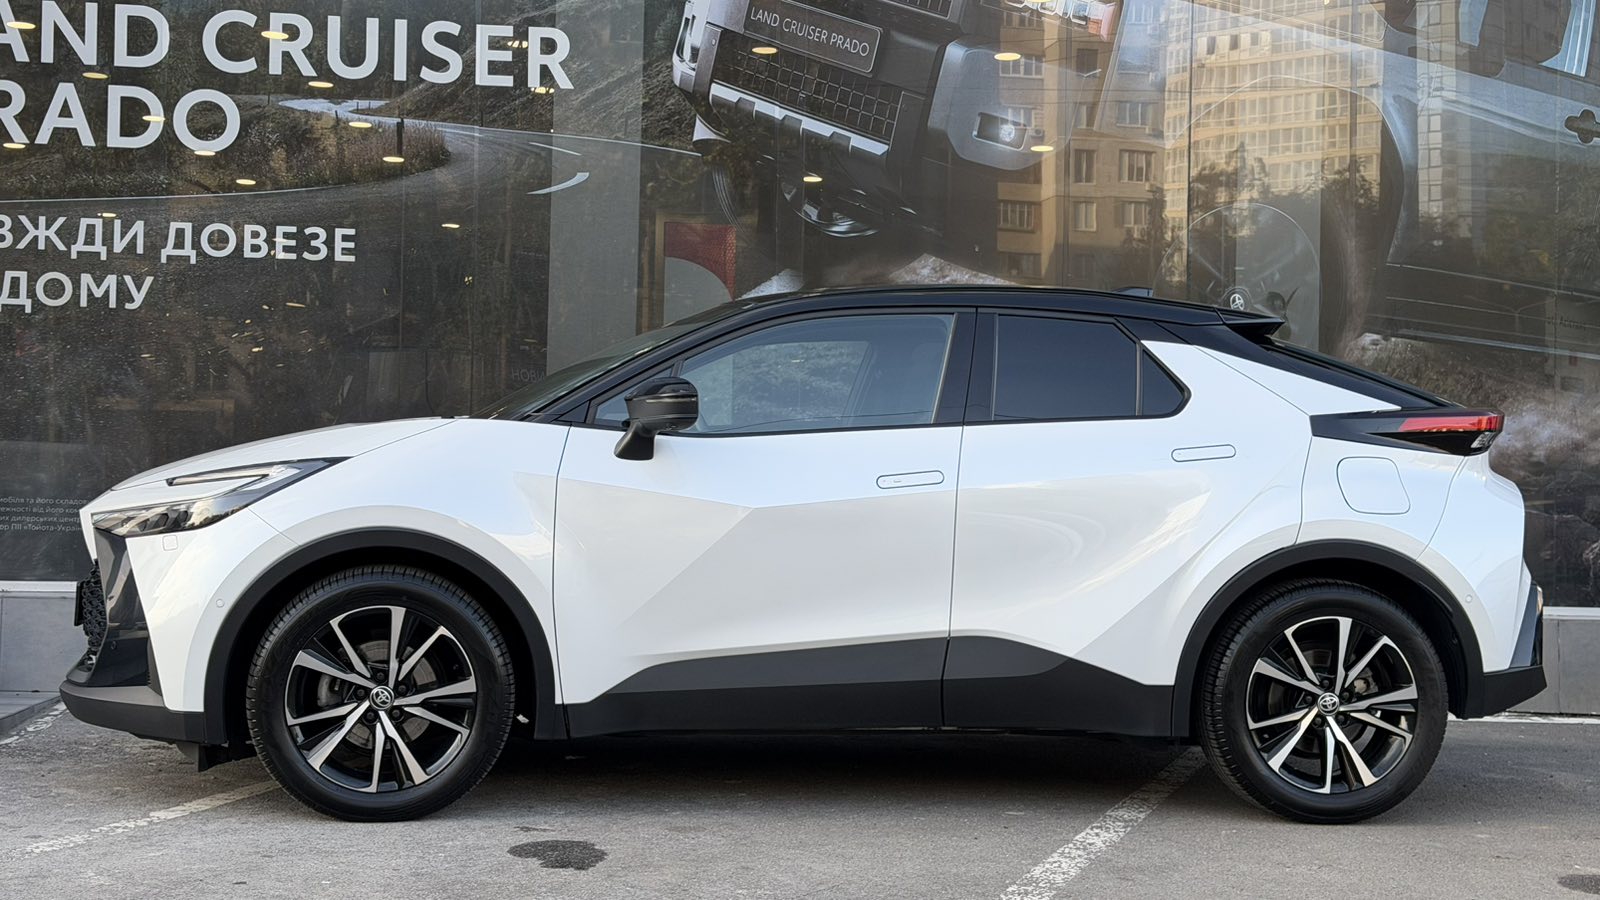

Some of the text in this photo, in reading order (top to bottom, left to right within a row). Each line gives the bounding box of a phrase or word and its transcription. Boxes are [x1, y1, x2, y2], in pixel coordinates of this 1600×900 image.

[202, 9, 574, 90] CRUISER
[750, 6, 870, 57] LAND CRUISER PRADO
[0, 79, 241, 154] RADO
[160, 221, 357, 264] ДОВЕЗЕ
[0, 270, 155, 314] ДОМУ
